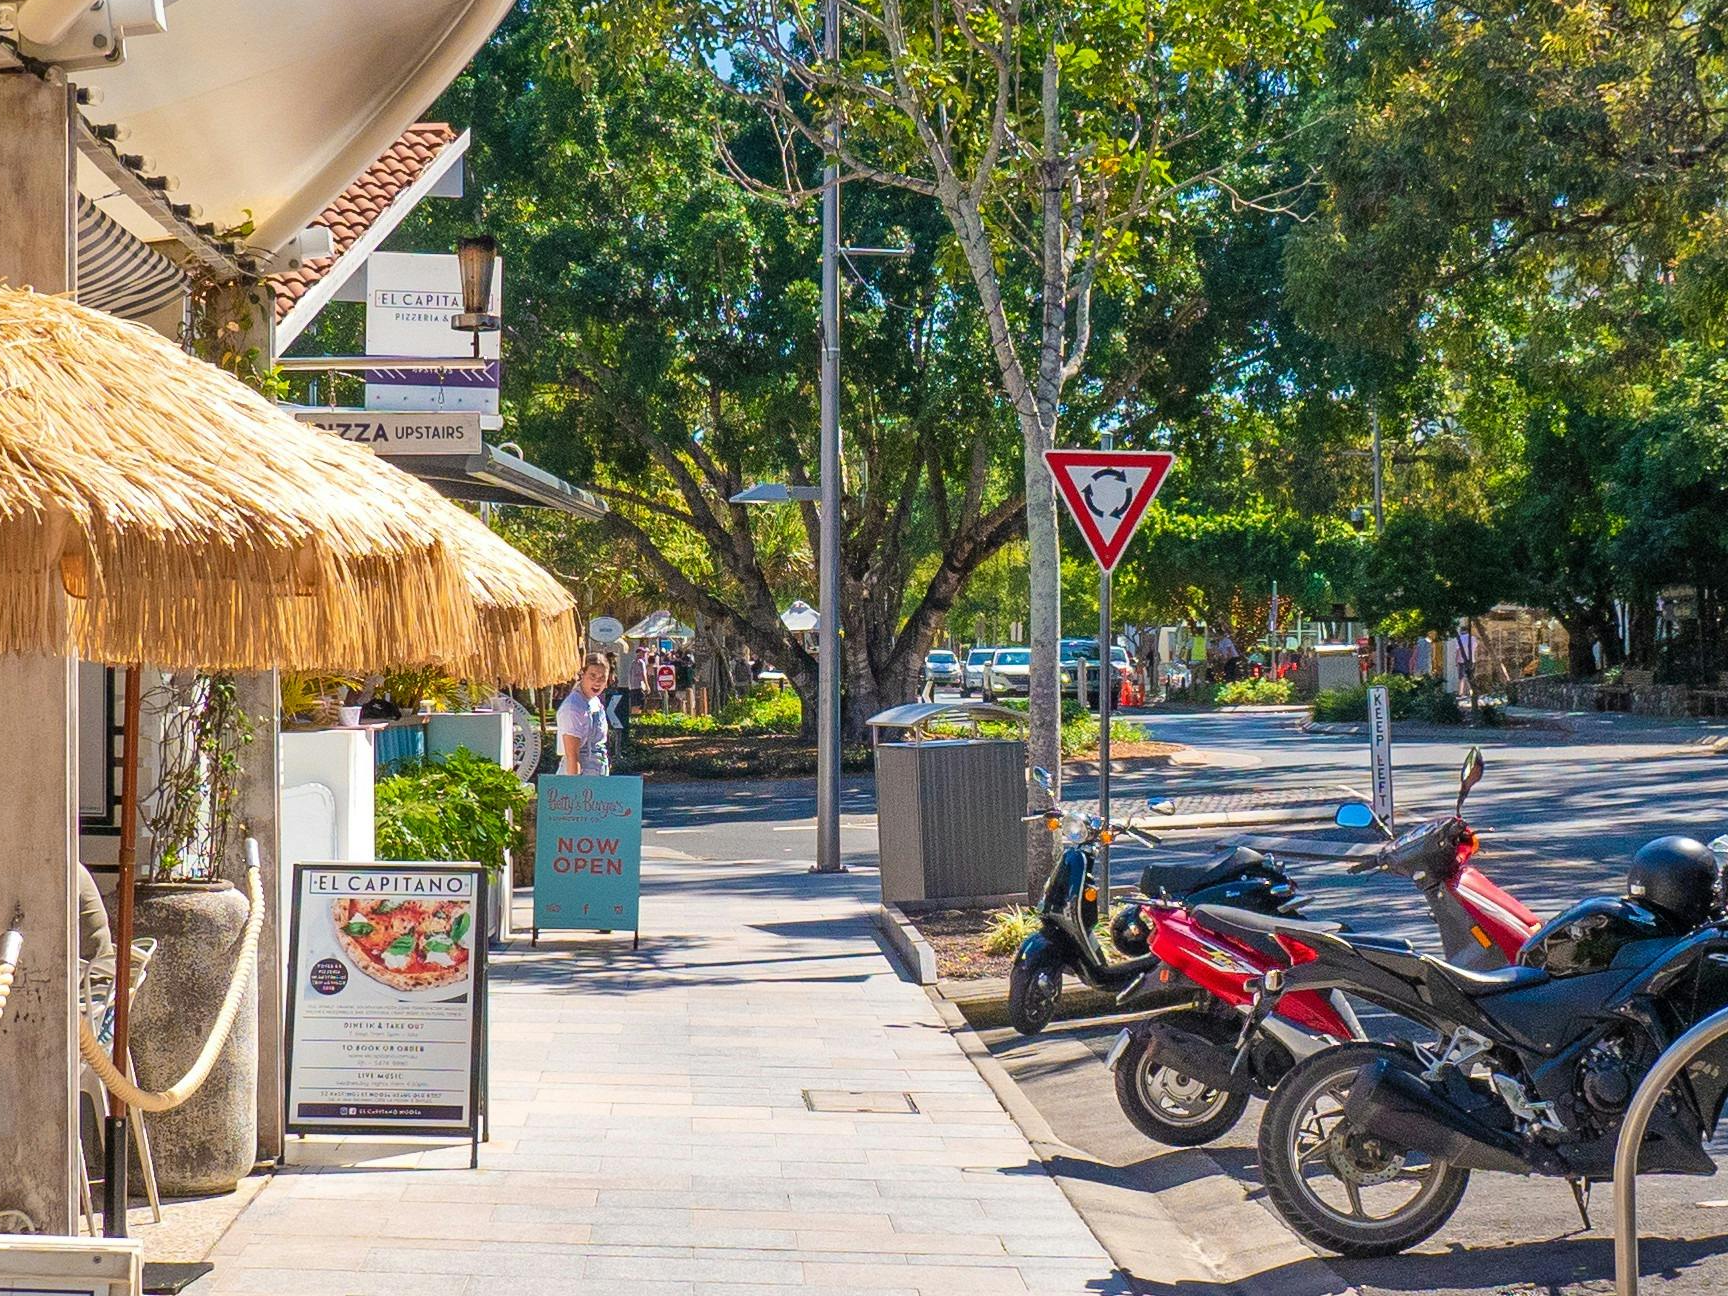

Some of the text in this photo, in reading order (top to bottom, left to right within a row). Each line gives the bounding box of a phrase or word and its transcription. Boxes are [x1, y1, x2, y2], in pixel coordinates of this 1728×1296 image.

[382, 294, 458, 306] EL CAPITA
[395, 312, 438, 322] PIZZERIA
[395, 424, 465, 441] UPSTAIRS
[1373, 694, 1387, 807] KEEP LEFT
[558, 837, 619, 854] NOW
[553, 857, 622, 875] OPEN
[319, 876, 463, 892] EL CAPITANO
